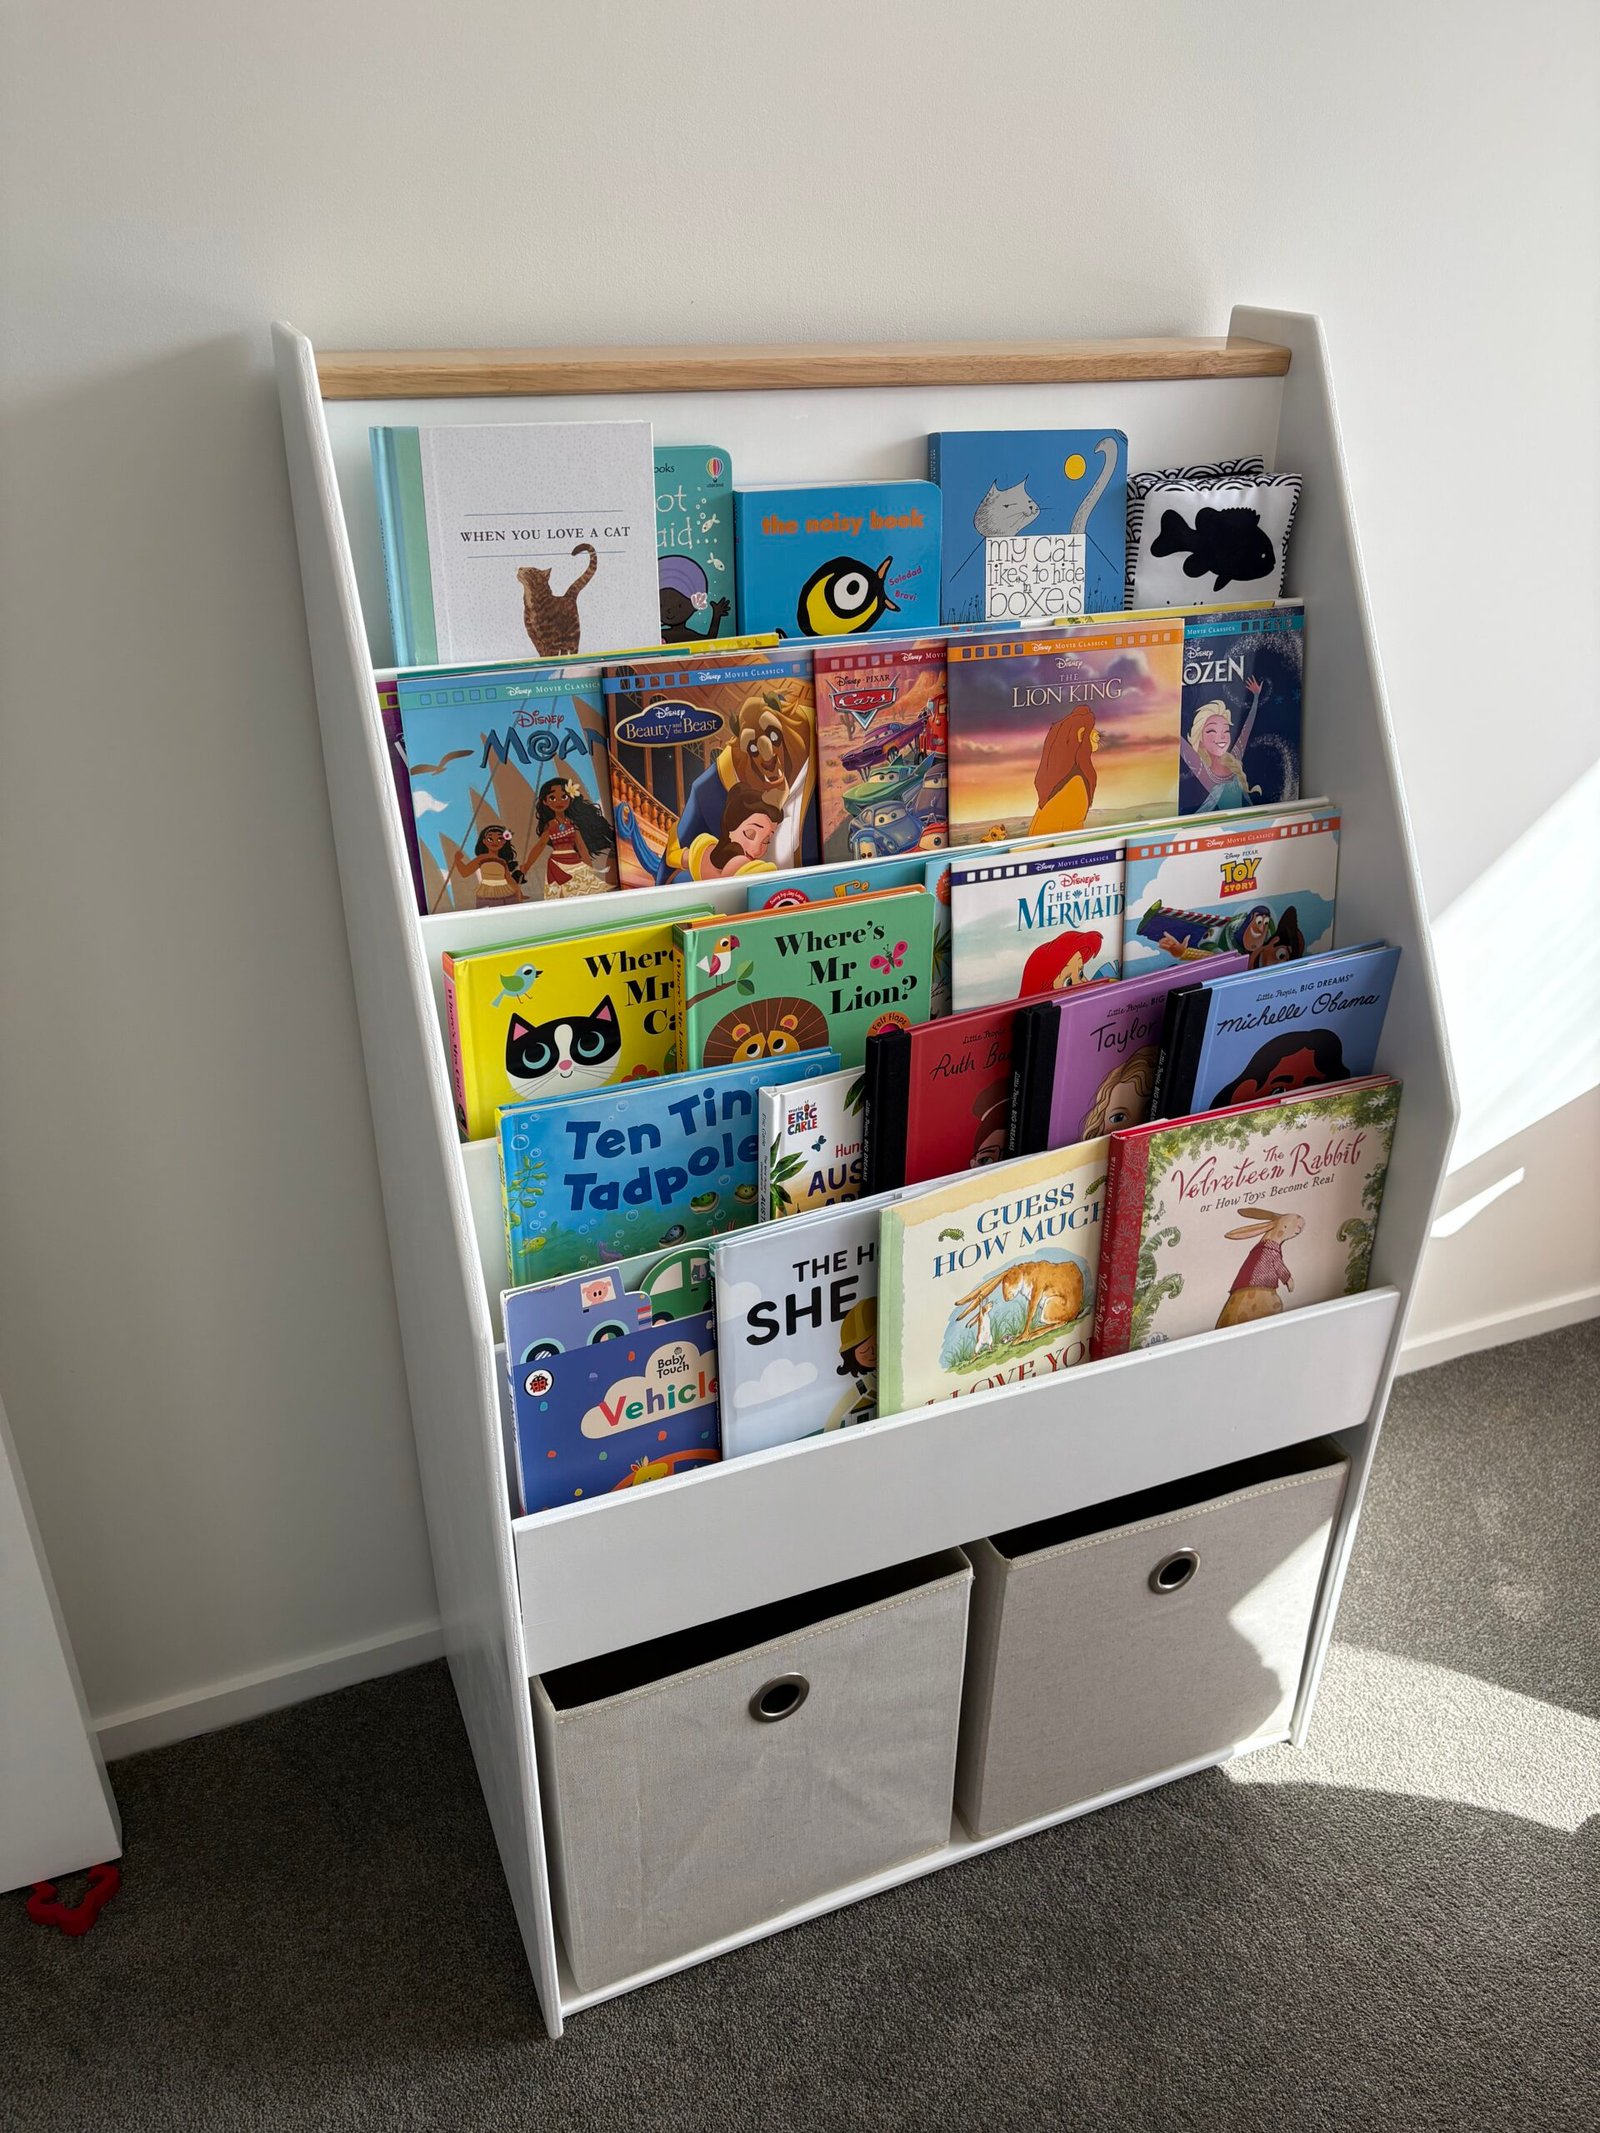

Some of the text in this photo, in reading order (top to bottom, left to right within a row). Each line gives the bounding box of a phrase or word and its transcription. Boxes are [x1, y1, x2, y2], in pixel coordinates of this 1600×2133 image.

[762, 507, 924, 536] the noisy book
[460, 526, 630, 543] WHEN YOU LOVE A CAT
[987, 538, 1030, 563] my
[888, 565, 922, 586] Soledad
[987, 563, 1085, 587] likes to hide
[987, 585, 1082, 618] boxes
[900, 652, 923, 662] Disney
[1032, 642, 1052, 652] Disney
[1185, 646, 1214, 659] Disney
[1055, 657, 1084, 669] Disney
[1182, 655, 1245, 686] OZEN
[697, 671, 722, 682] Disney
[1059, 674, 1079, 682] THE
[505, 686, 532, 697] Disney
[838, 692, 887, 707] Cars
[1012, 678, 1122, 708] LION KING
[512, 710, 565, 729] Disney
[653, 706, 686, 720] Disney
[625, 723, 672, 740] Beauty
[683, 717, 718, 734] Beast
[1204, 838, 1225, 848] Disney
[1034, 862, 1056, 872] Disney
[1220, 857, 1262, 883] TOY
[1058, 873, 1101, 888] Disney's
[1223, 880, 1255, 893] STORY
[1048, 881, 1126, 904] THE LITTLE
[1017, 879, 1126, 932] MERMAID
[774, 920, 885, 958] Where's
[808, 954, 858, 987] Mr
[828, 974, 918, 1016] Lion?
[1300, 982, 1315, 992] BIG
[1151, 994, 1166, 1006] BIG
[872, 1012, 907, 1031] Felt flaps
[1217, 991, 1380, 1036] Michelle Obama
[1089, 1017, 1157, 1053] Taylor
[929, 1051, 976, 1081] Ruth
[565, 1087, 759, 1160] Ten Tin
[787, 1118, 818, 1136] CARLE
[1263, 1145, 1285, 1163] The
[1171, 1132, 1368, 1204] Velveteen Rabbit
[1200, 1173, 1335, 1214] or How Toys Become Real
[976, 1181, 1075, 1234] GUESS
[792, 1242, 879, 1283] THE H
[931, 1230, 1011, 1280] HOW
[746, 1275, 860, 1346] SHE
[657, 1353, 686, 1370] Baby
[1044, 1338, 1092, 1373] YO
[656, 1361, 690, 1379] Touch
